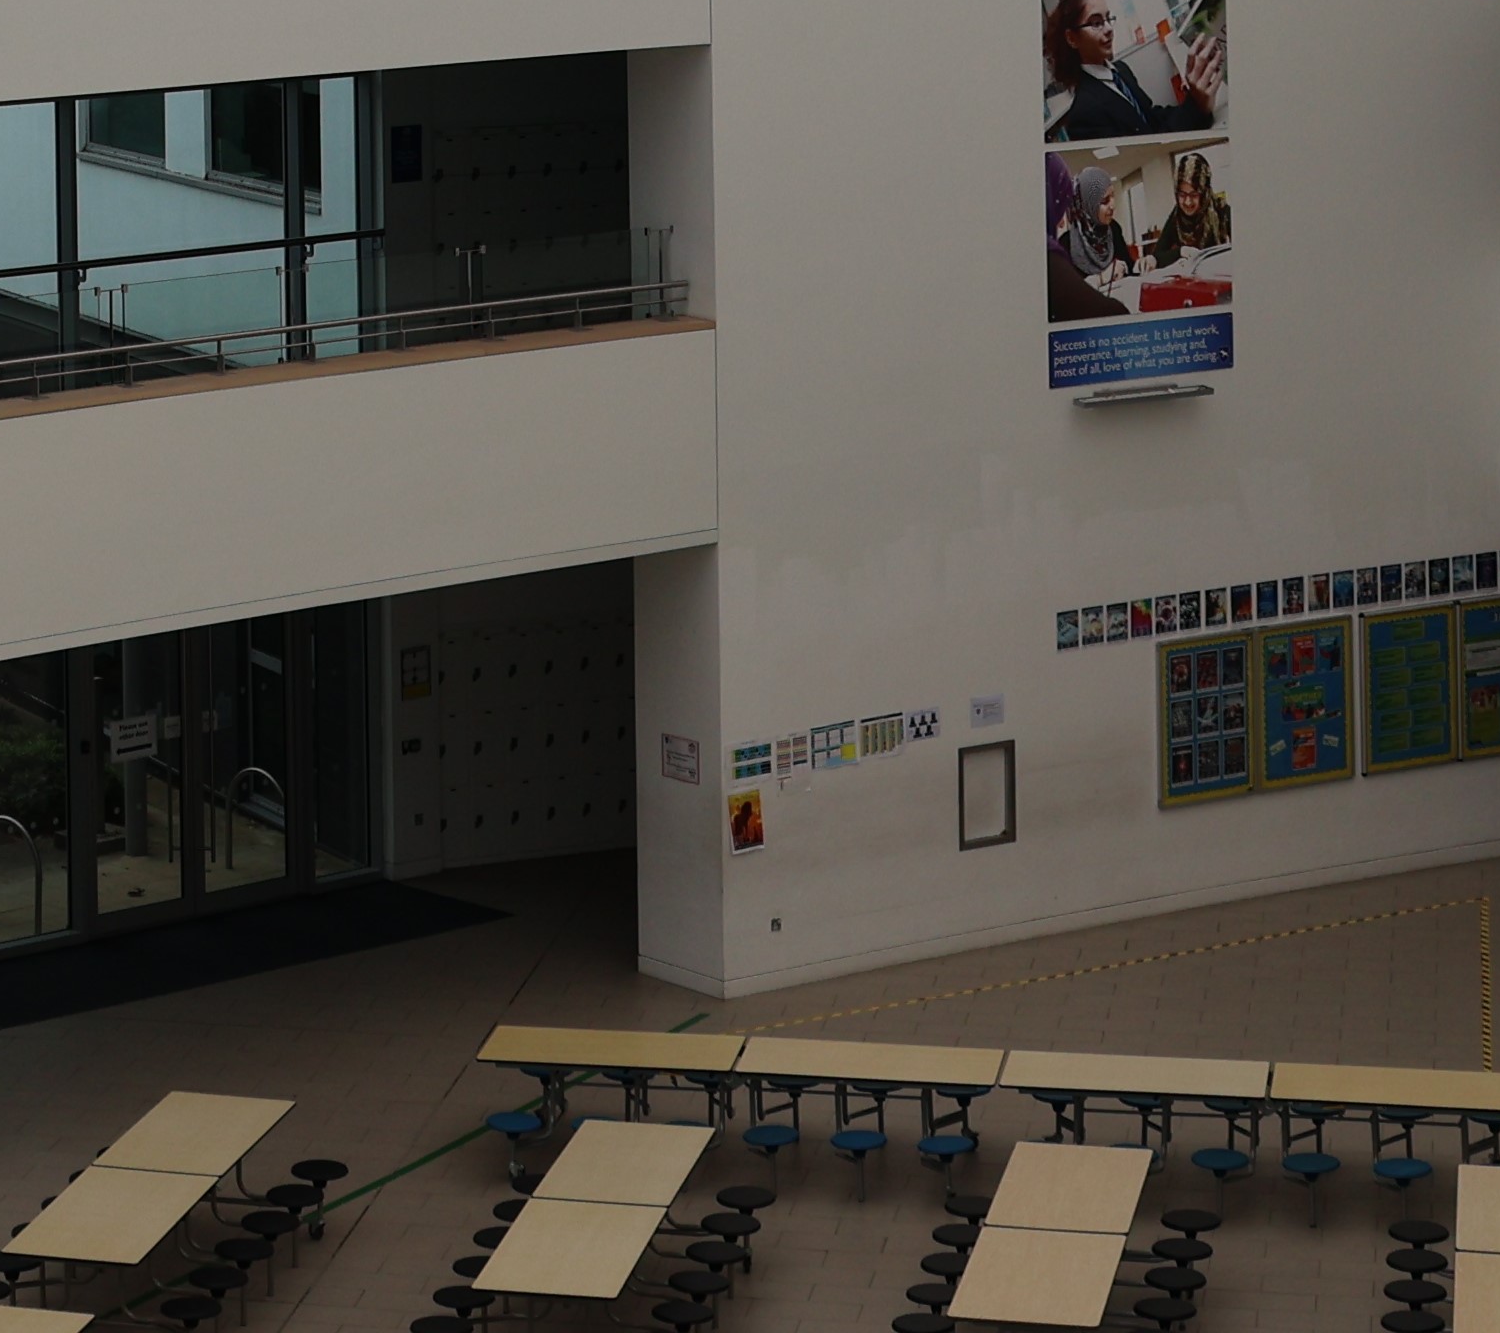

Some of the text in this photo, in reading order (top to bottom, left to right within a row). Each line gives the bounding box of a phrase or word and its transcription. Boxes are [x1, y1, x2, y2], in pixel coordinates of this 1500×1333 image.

[1054, 340, 1086, 352] Success
[1089, 338, 1096, 347] is
[1098, 337, 1110, 347] no
[1154, 330, 1161, 341] It
[1163, 330, 1170, 339] is
[1172, 327, 1192, 339] hard
[1152, 339, 1187, 355] studying
[1054, 366, 1076, 378] most
[1078, 363, 1088, 375] of
[1103, 359, 1120, 371] love
[1123, 357, 1133, 370] of
[1135, 355, 1156, 368] what
[1158, 356, 1174, 369] you
[1176, 354, 1190, 364] are
